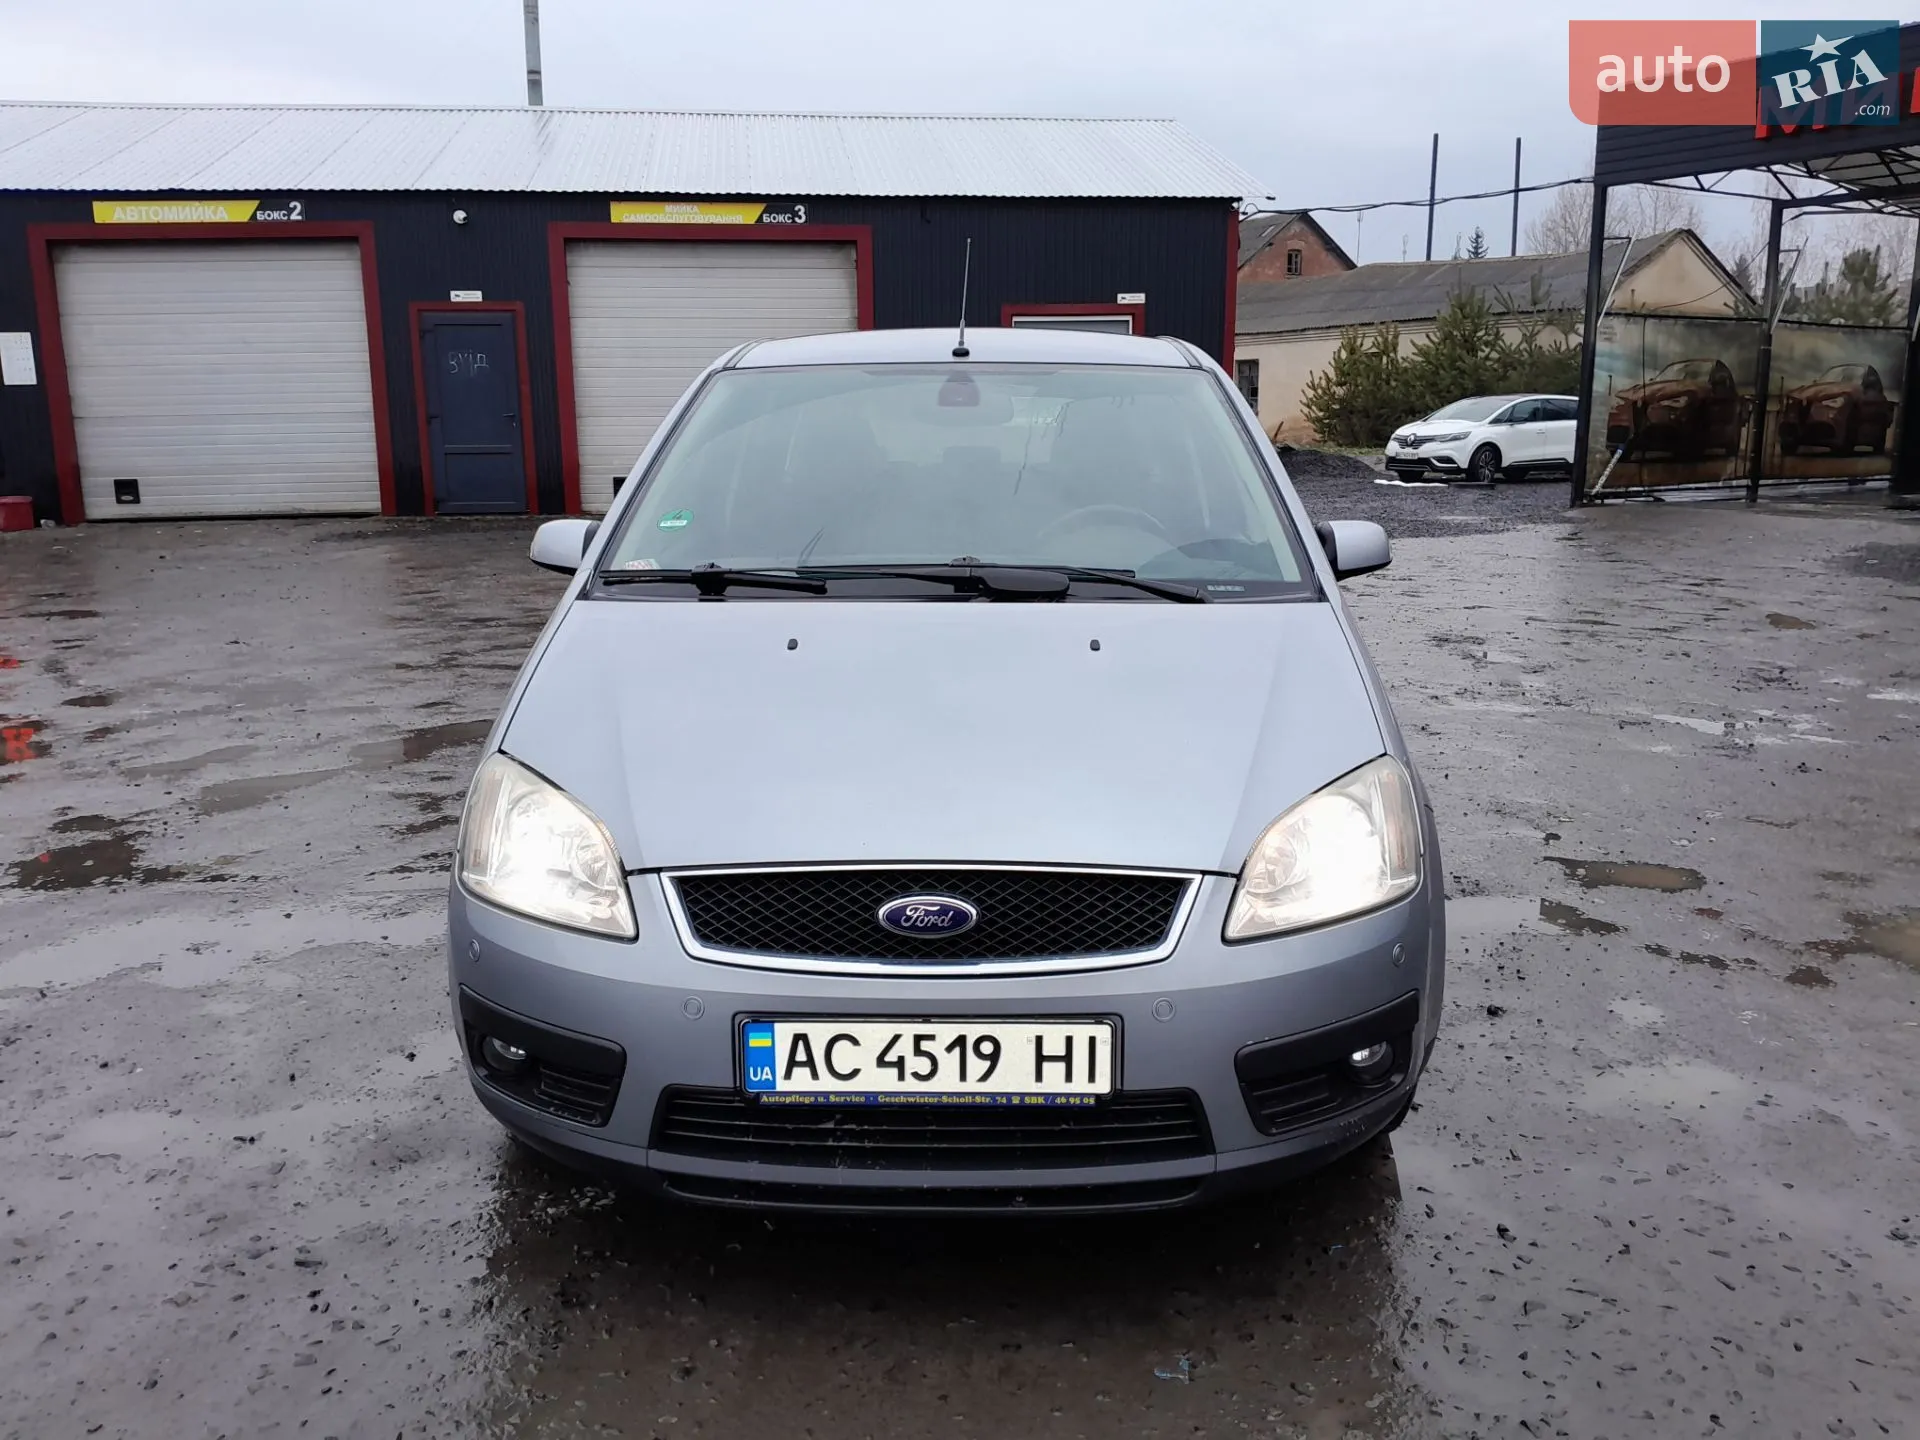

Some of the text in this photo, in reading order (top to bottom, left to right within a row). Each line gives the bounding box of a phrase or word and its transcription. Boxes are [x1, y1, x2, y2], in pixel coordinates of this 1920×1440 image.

[112, 203, 229, 221] АВТОМИЙКА
[256, 201, 303, 221] БОКС 2
[762, 204, 807, 223] БОКС 3
[900, 904, 955, 928] Ford
[783, 1033, 1097, 1084] AC 4519 HI
[750, 1066, 773, 1082] UA
[760, 1095, 816, 1104] Autopflege
[829, 1095, 866, 1103] Service
